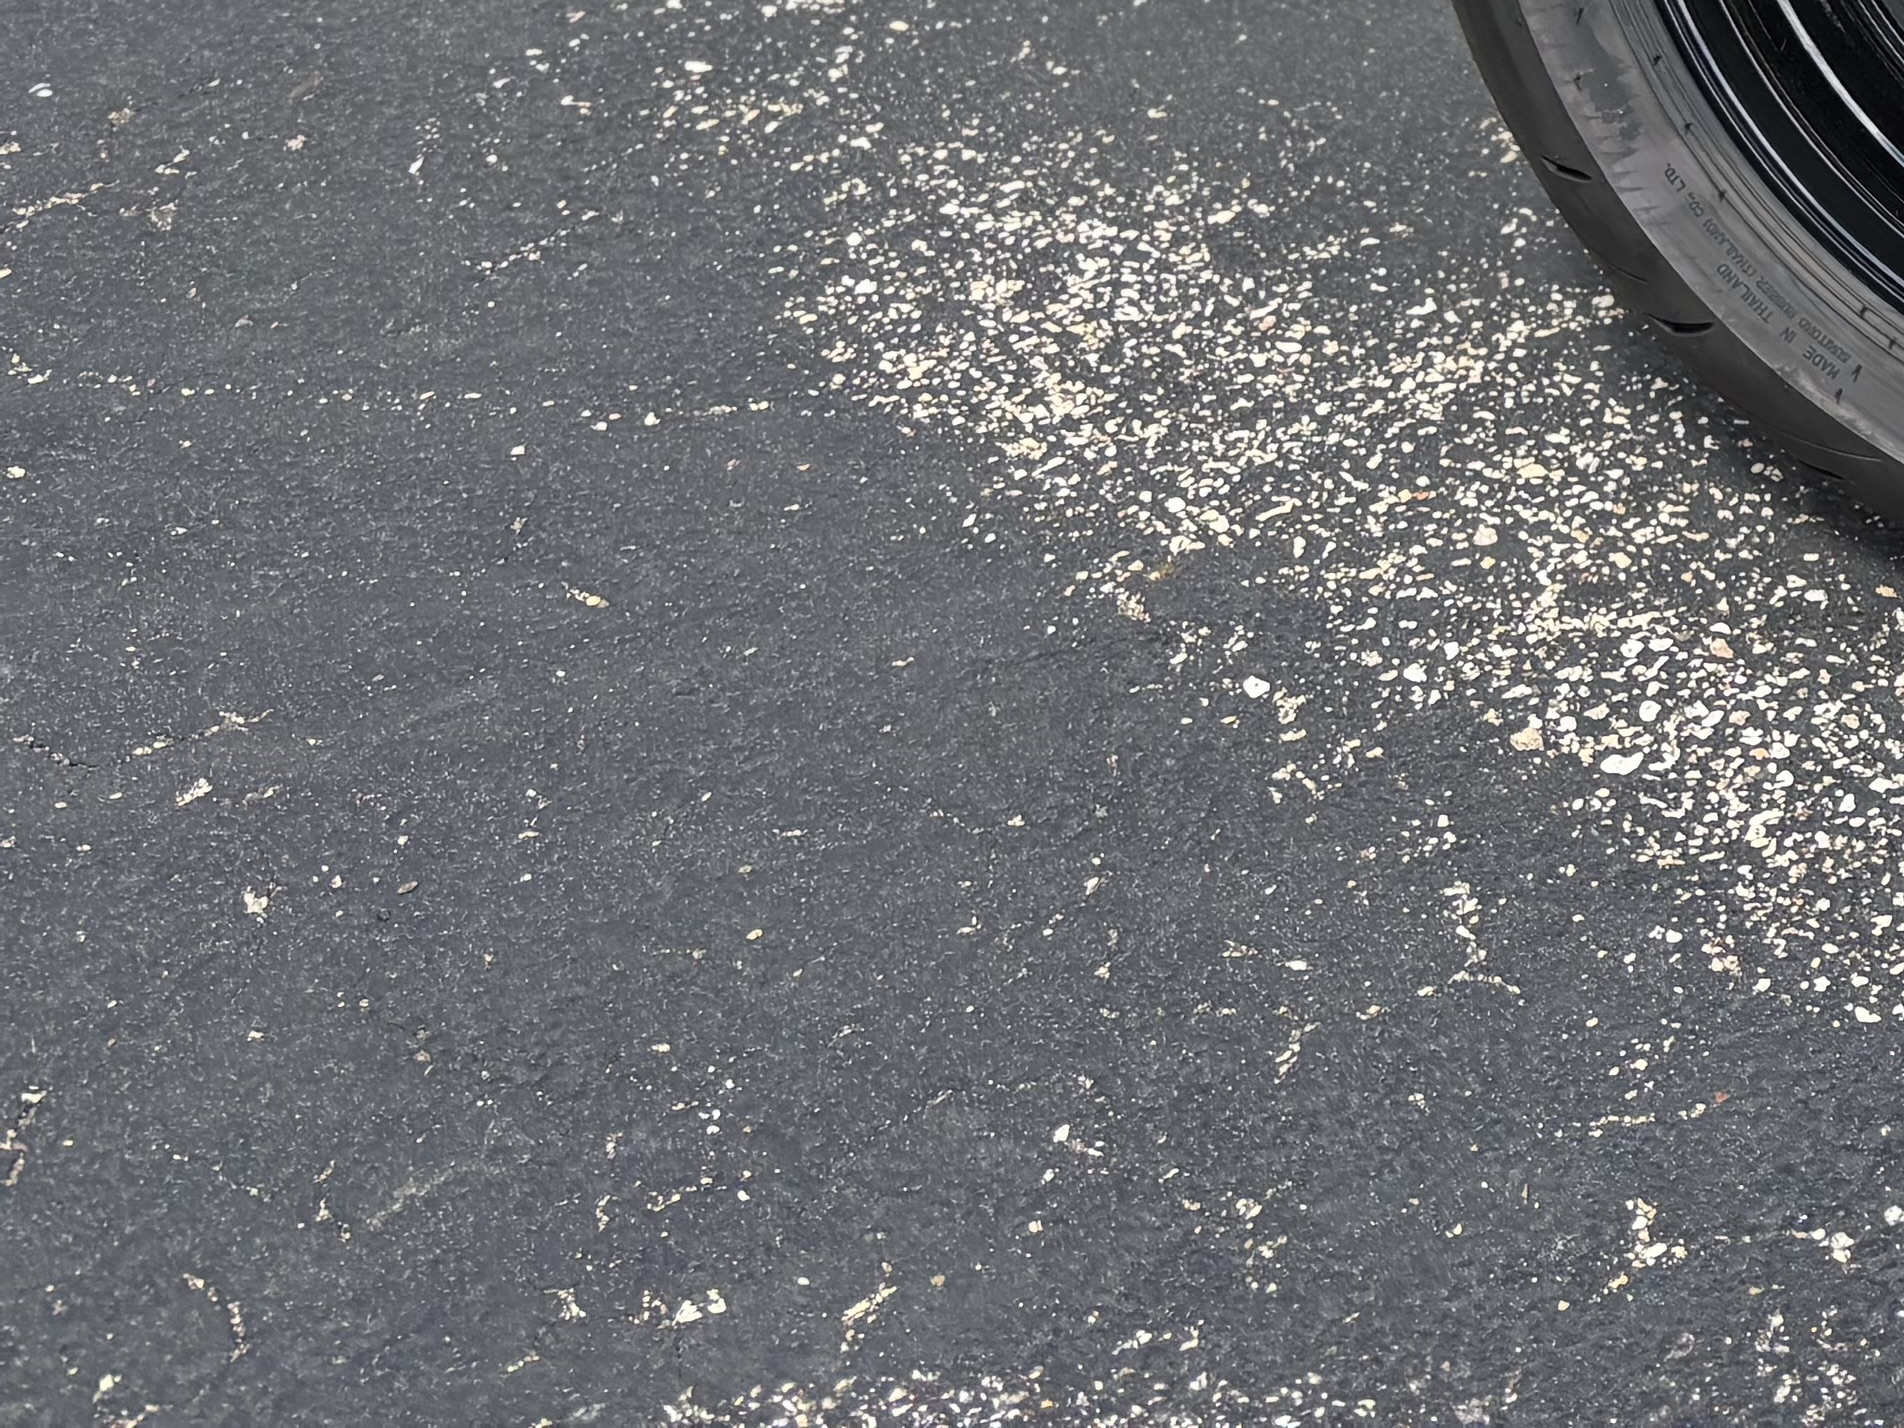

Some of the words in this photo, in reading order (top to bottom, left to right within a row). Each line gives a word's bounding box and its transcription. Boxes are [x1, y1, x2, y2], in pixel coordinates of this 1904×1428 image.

[1663, 162, 1687, 192] LTD.
[1716, 263, 1774, 323] THAILAND
[1778, 326, 1798, 344] IN
[1803, 345, 1841, 380] MADE
